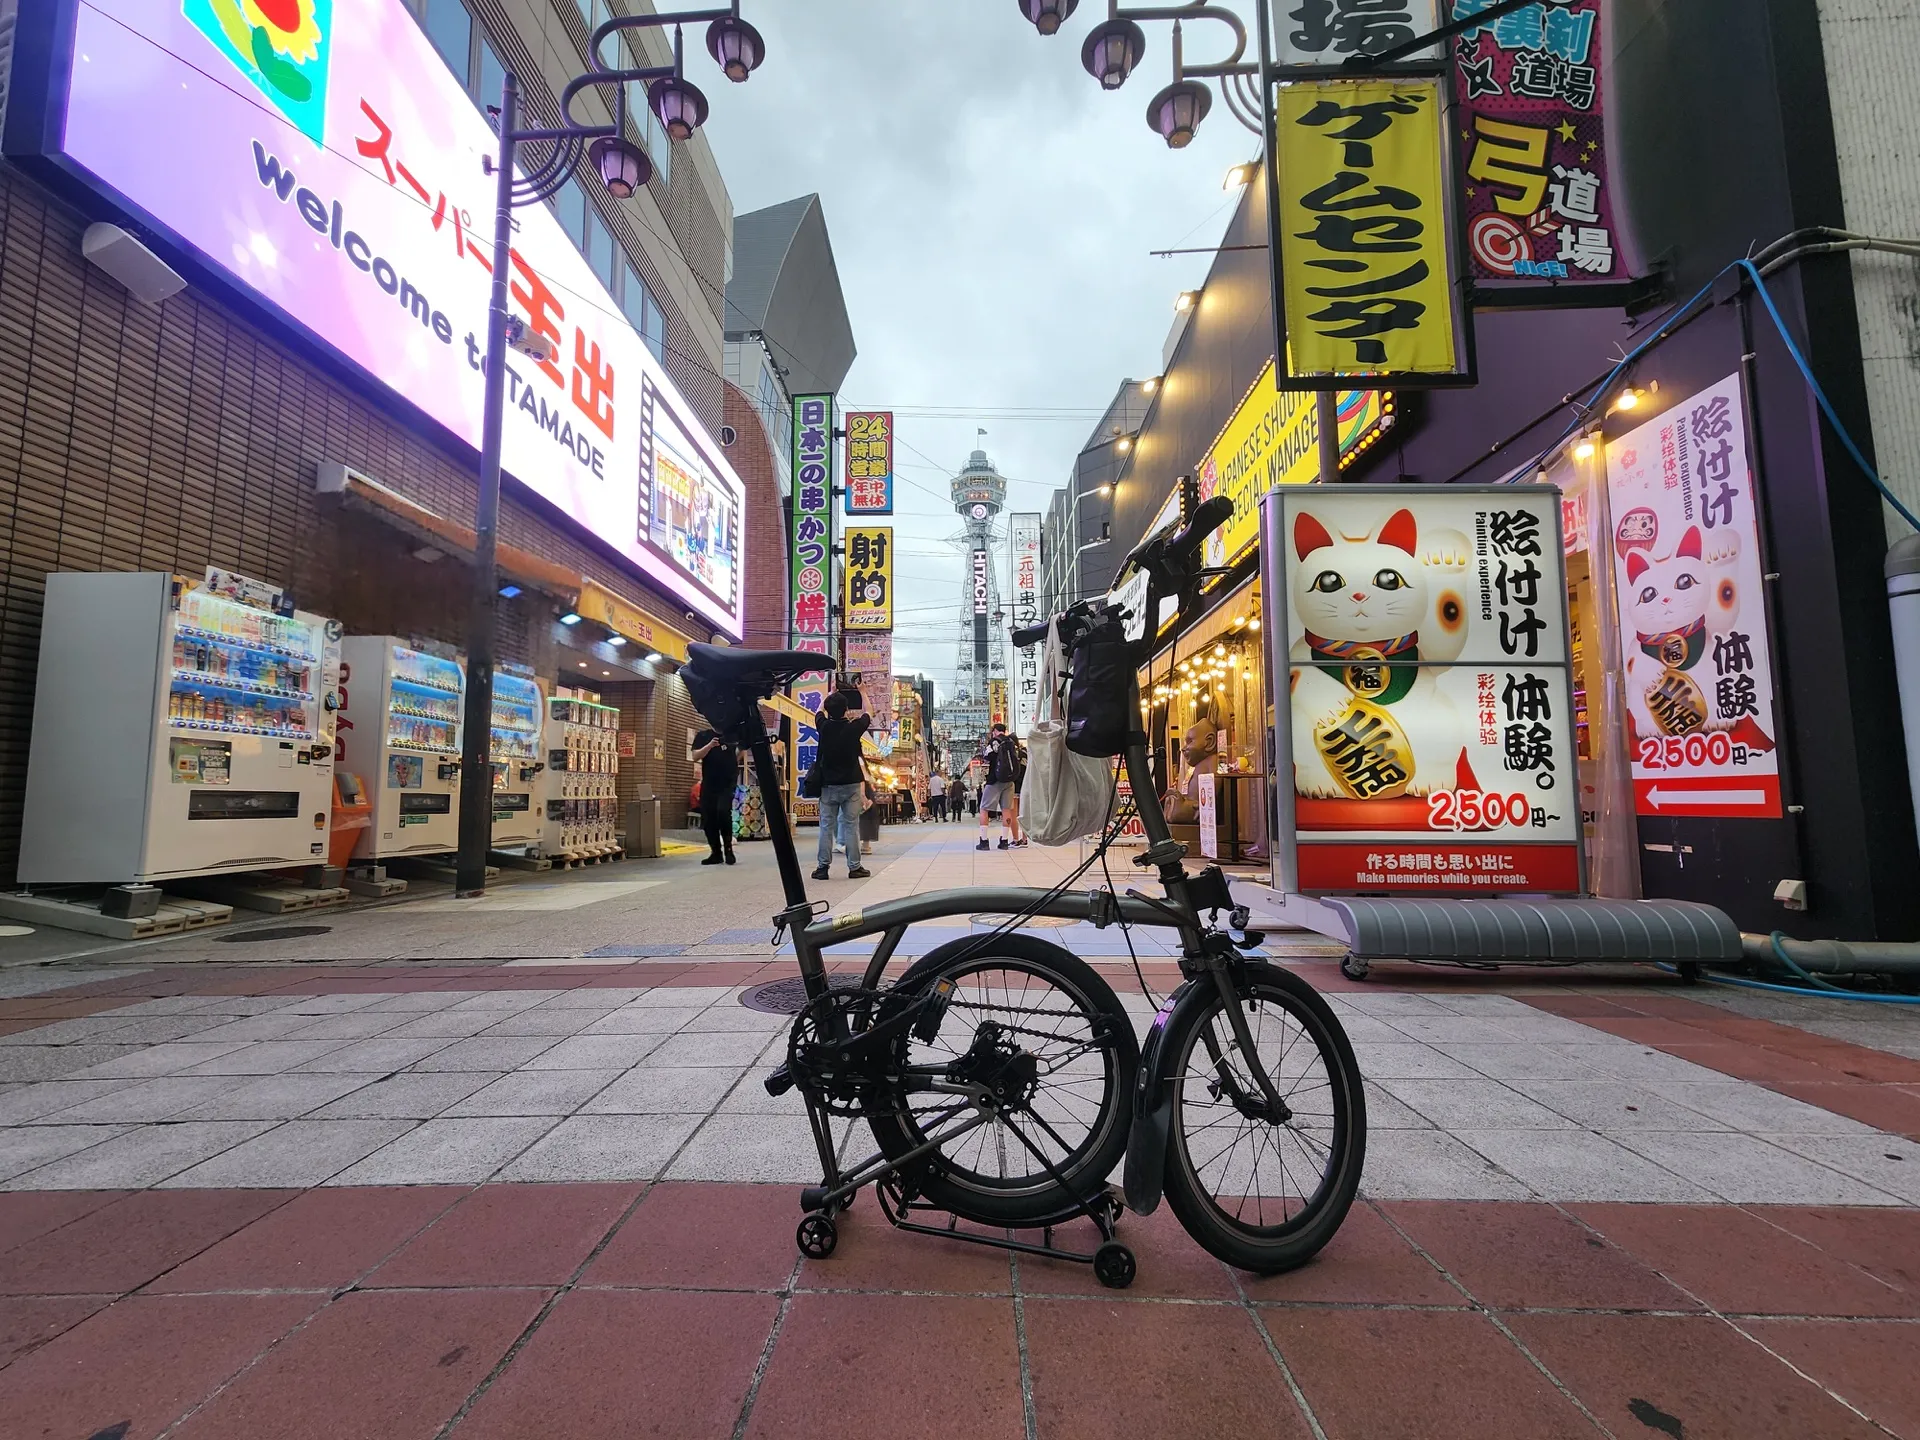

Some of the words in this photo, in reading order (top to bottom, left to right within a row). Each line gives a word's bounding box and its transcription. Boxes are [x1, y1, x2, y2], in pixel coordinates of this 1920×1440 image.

[1510, 52, 1596, 109] 道場
[1293, 93, 1430, 364] ゲームセンター
[1512, 258, 1569, 278] NICE!
[252, 139, 452, 344] welcome
[464, 331, 487, 378] t
[504, 362, 605, 481] TAMADE
[850, 415, 888, 440] 24
[850, 441, 887, 459] 時間
[1676, 416, 1689, 461] Painting
[797, 401, 826, 565] 日本一の串かつ
[849, 459, 887, 478] 営業
[853, 480, 886, 494] 年中
[1219, 421, 1262, 498] JAPANESE
[1691, 396, 1739, 529] 絵付け
[853, 494, 886, 508] 無休
[1679, 462, 1694, 521] experience
[1475, 511, 1488, 557] Painting
[850, 533, 887, 606] 射的
[974, 551, 987, 614] HITACHI
[1478, 559, 1493, 621] experience
[1018, 556, 1038, 695] 元祖串カ専門店
[1663, 638, 1683, 663] 福
[1350, 656, 1382, 690] 福
[1713, 631, 1760, 719] 体験
[1476, 673, 1499, 745] 彩绘体验
[1357, 872, 1385, 884] Make
[1387, 872, 1440, 884] memories
[1441, 873, 1470, 884] while
[1472, 875, 1491, 886] you
[1492, 874, 1530, 885] create.
[1366, 854, 1514, 870] 作る時間も思い出に
